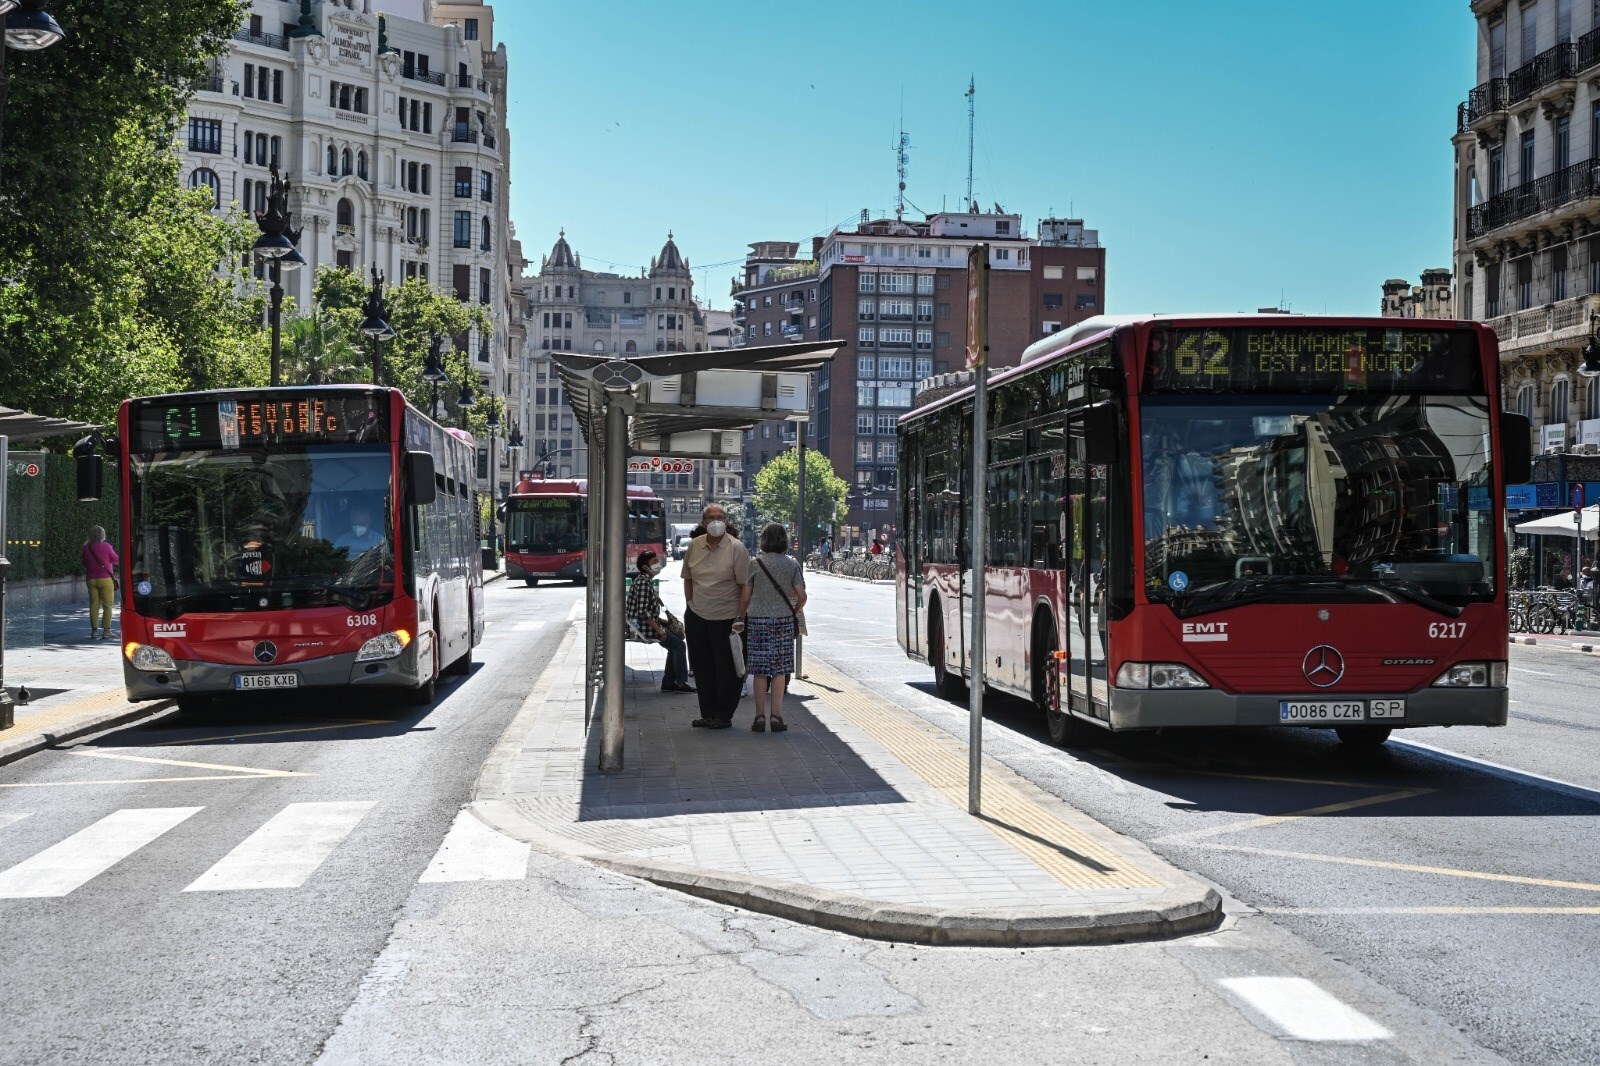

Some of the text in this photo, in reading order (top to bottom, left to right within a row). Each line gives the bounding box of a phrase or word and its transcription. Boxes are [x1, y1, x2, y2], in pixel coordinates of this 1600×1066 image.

[1174, 335, 1229, 375] 62
[1314, 354, 1353, 372] DEL
[1360, 354, 1417, 372] NORD
[166, 401, 325, 438] C1 CENTRE
[153, 623, 187, 632] EMT
[346, 614, 377, 627] 6308
[1182, 622, 1228, 634] EMT
[1428, 622, 1467, 639] 6217
[1383, 658, 1435, 666] CITARO
[243, 675, 295, 687] 8166 KXB
[1290, 705, 1328, 719] 0086
[1333, 704, 1361, 718] CZR
